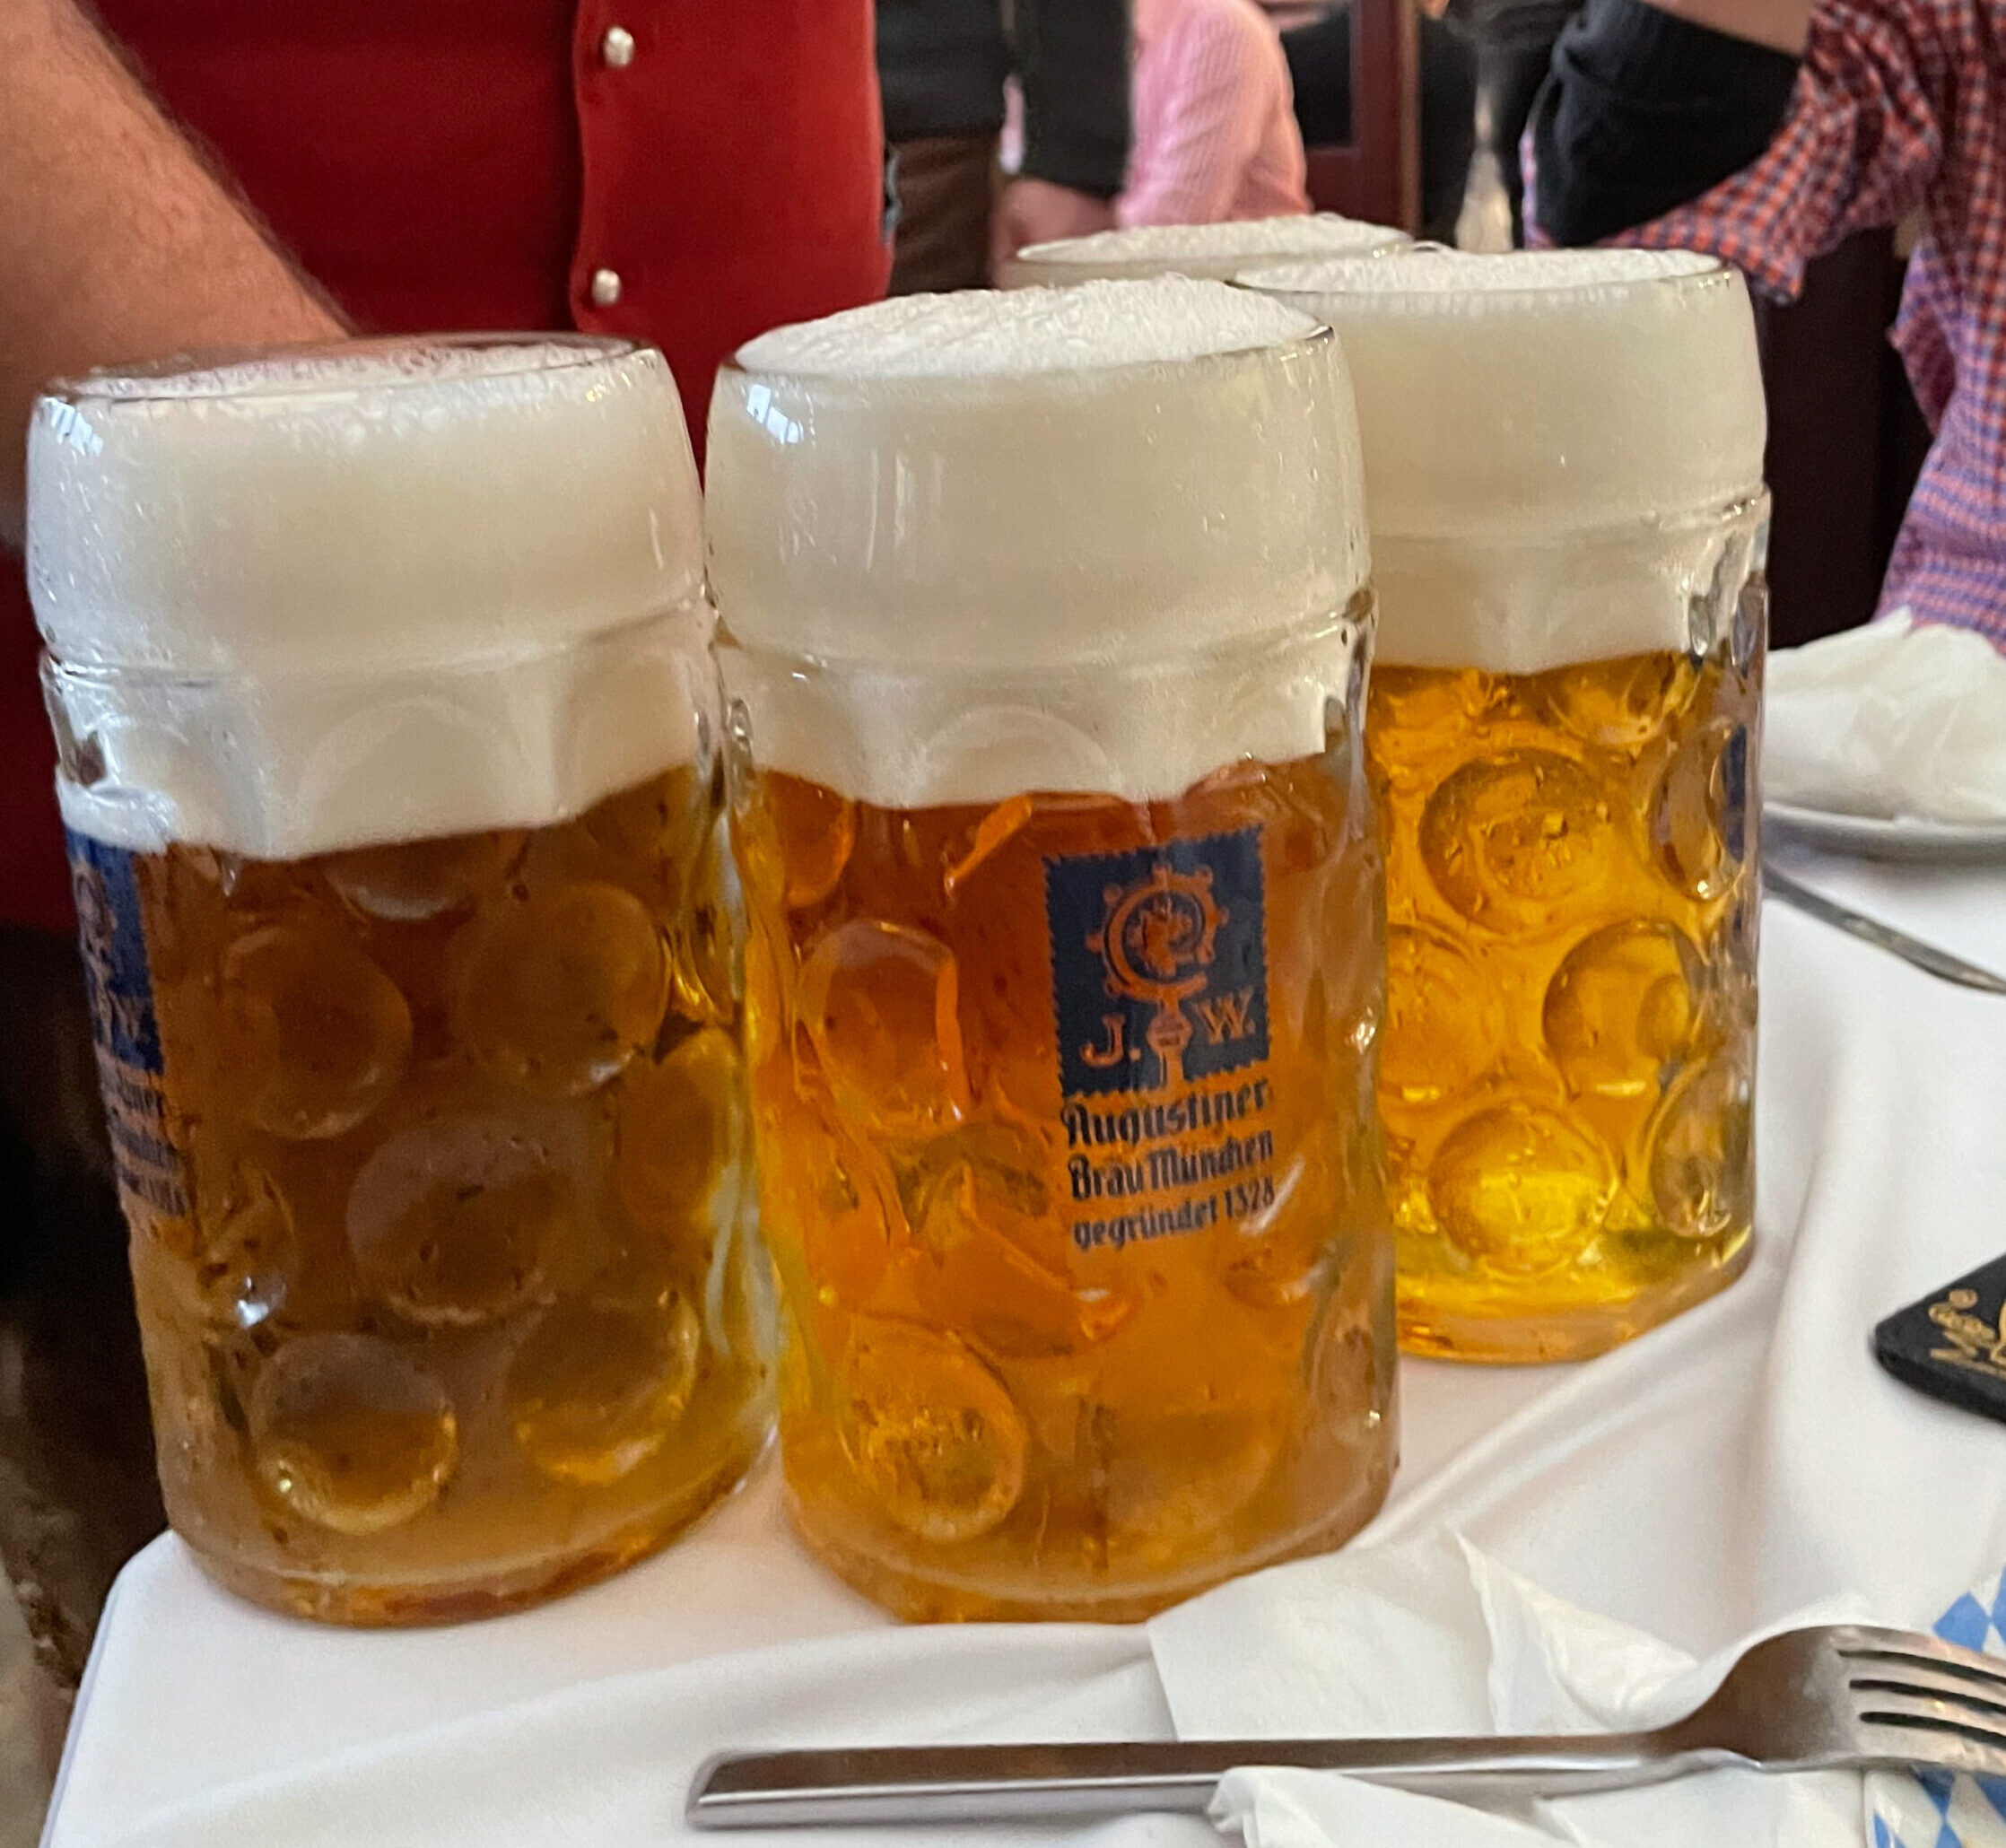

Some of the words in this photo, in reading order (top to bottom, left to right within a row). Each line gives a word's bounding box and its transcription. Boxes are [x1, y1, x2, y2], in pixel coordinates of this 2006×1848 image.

[1061, 1078, 1268, 1147] Augustiner
[1147, 1129, 1273, 1190] München
[1075, 1195, 1217, 1250] gegründet
